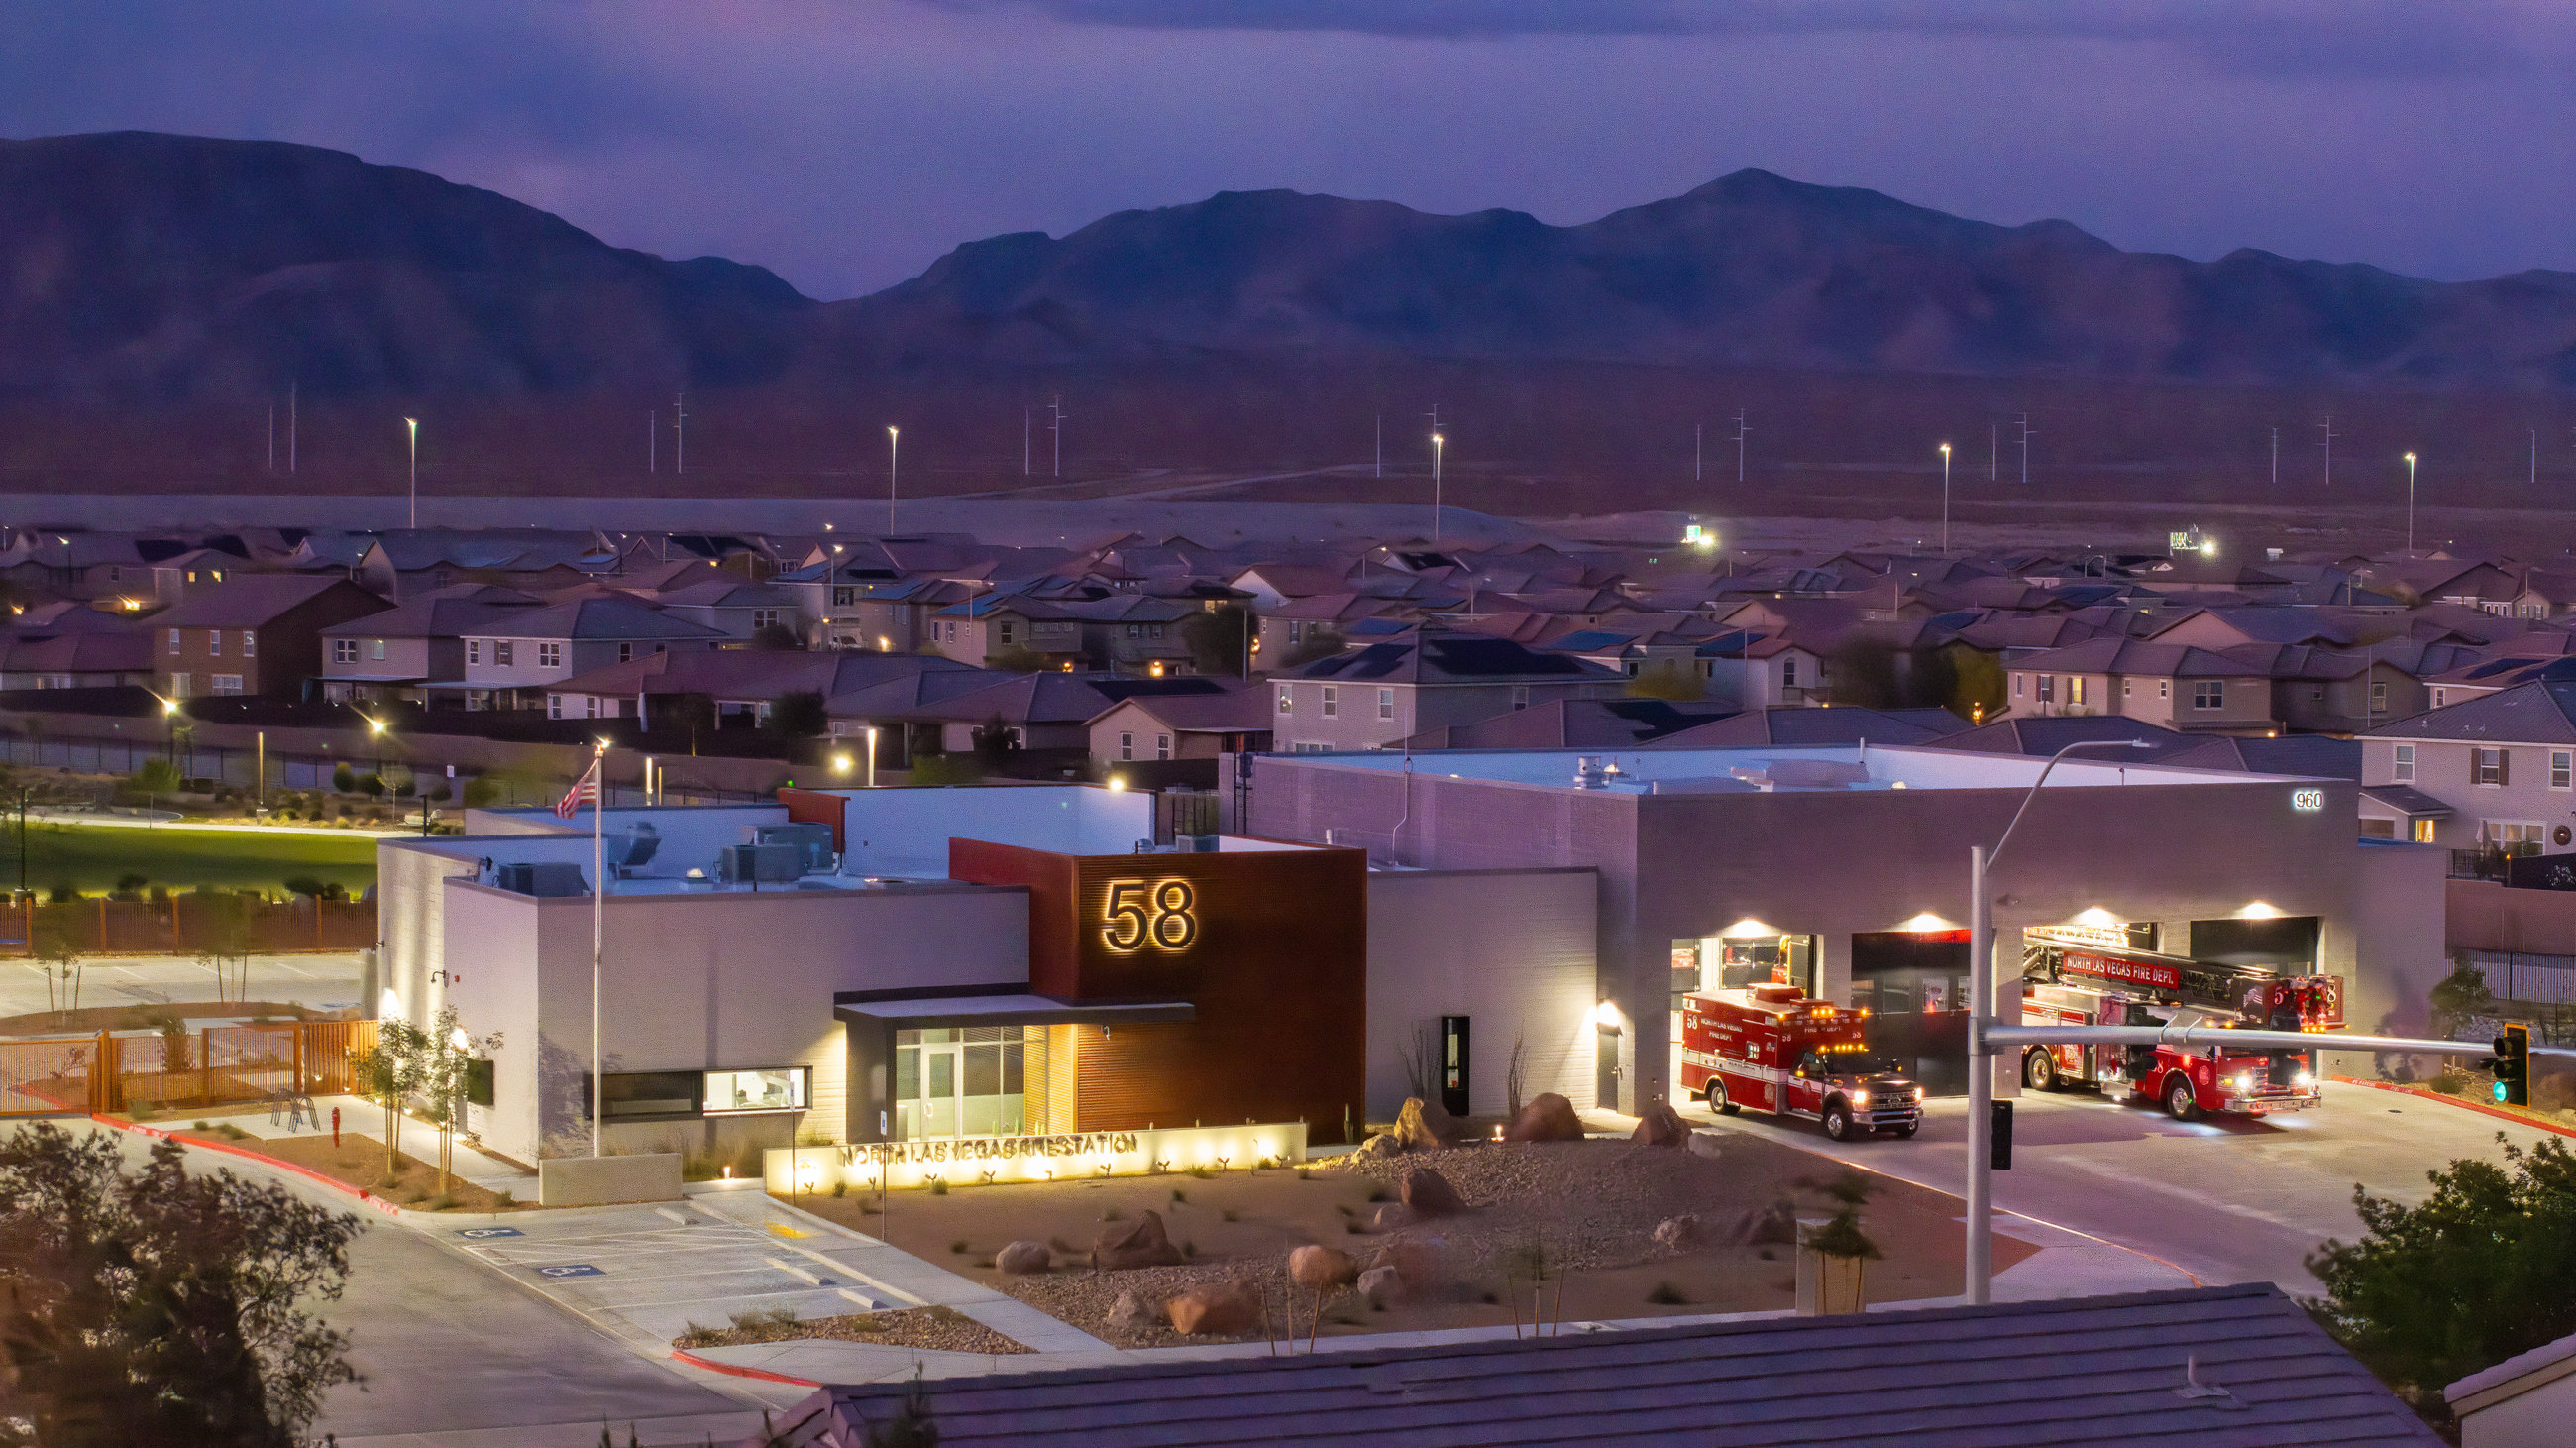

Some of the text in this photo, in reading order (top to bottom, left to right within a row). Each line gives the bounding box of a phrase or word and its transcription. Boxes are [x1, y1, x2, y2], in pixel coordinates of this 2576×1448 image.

[2296, 793, 2323, 808] 960
[1105, 881, 1196, 949] 58
[2067, 954, 2174, 984] NORTH LAS VEGAS FIRE DEPT.
[2327, 983, 2337, 1003] 8
[1686, 1013, 1698, 1030] 58
[837, 1133, 1138, 1167] NORTH LAS VEGAS FIRE STATION
